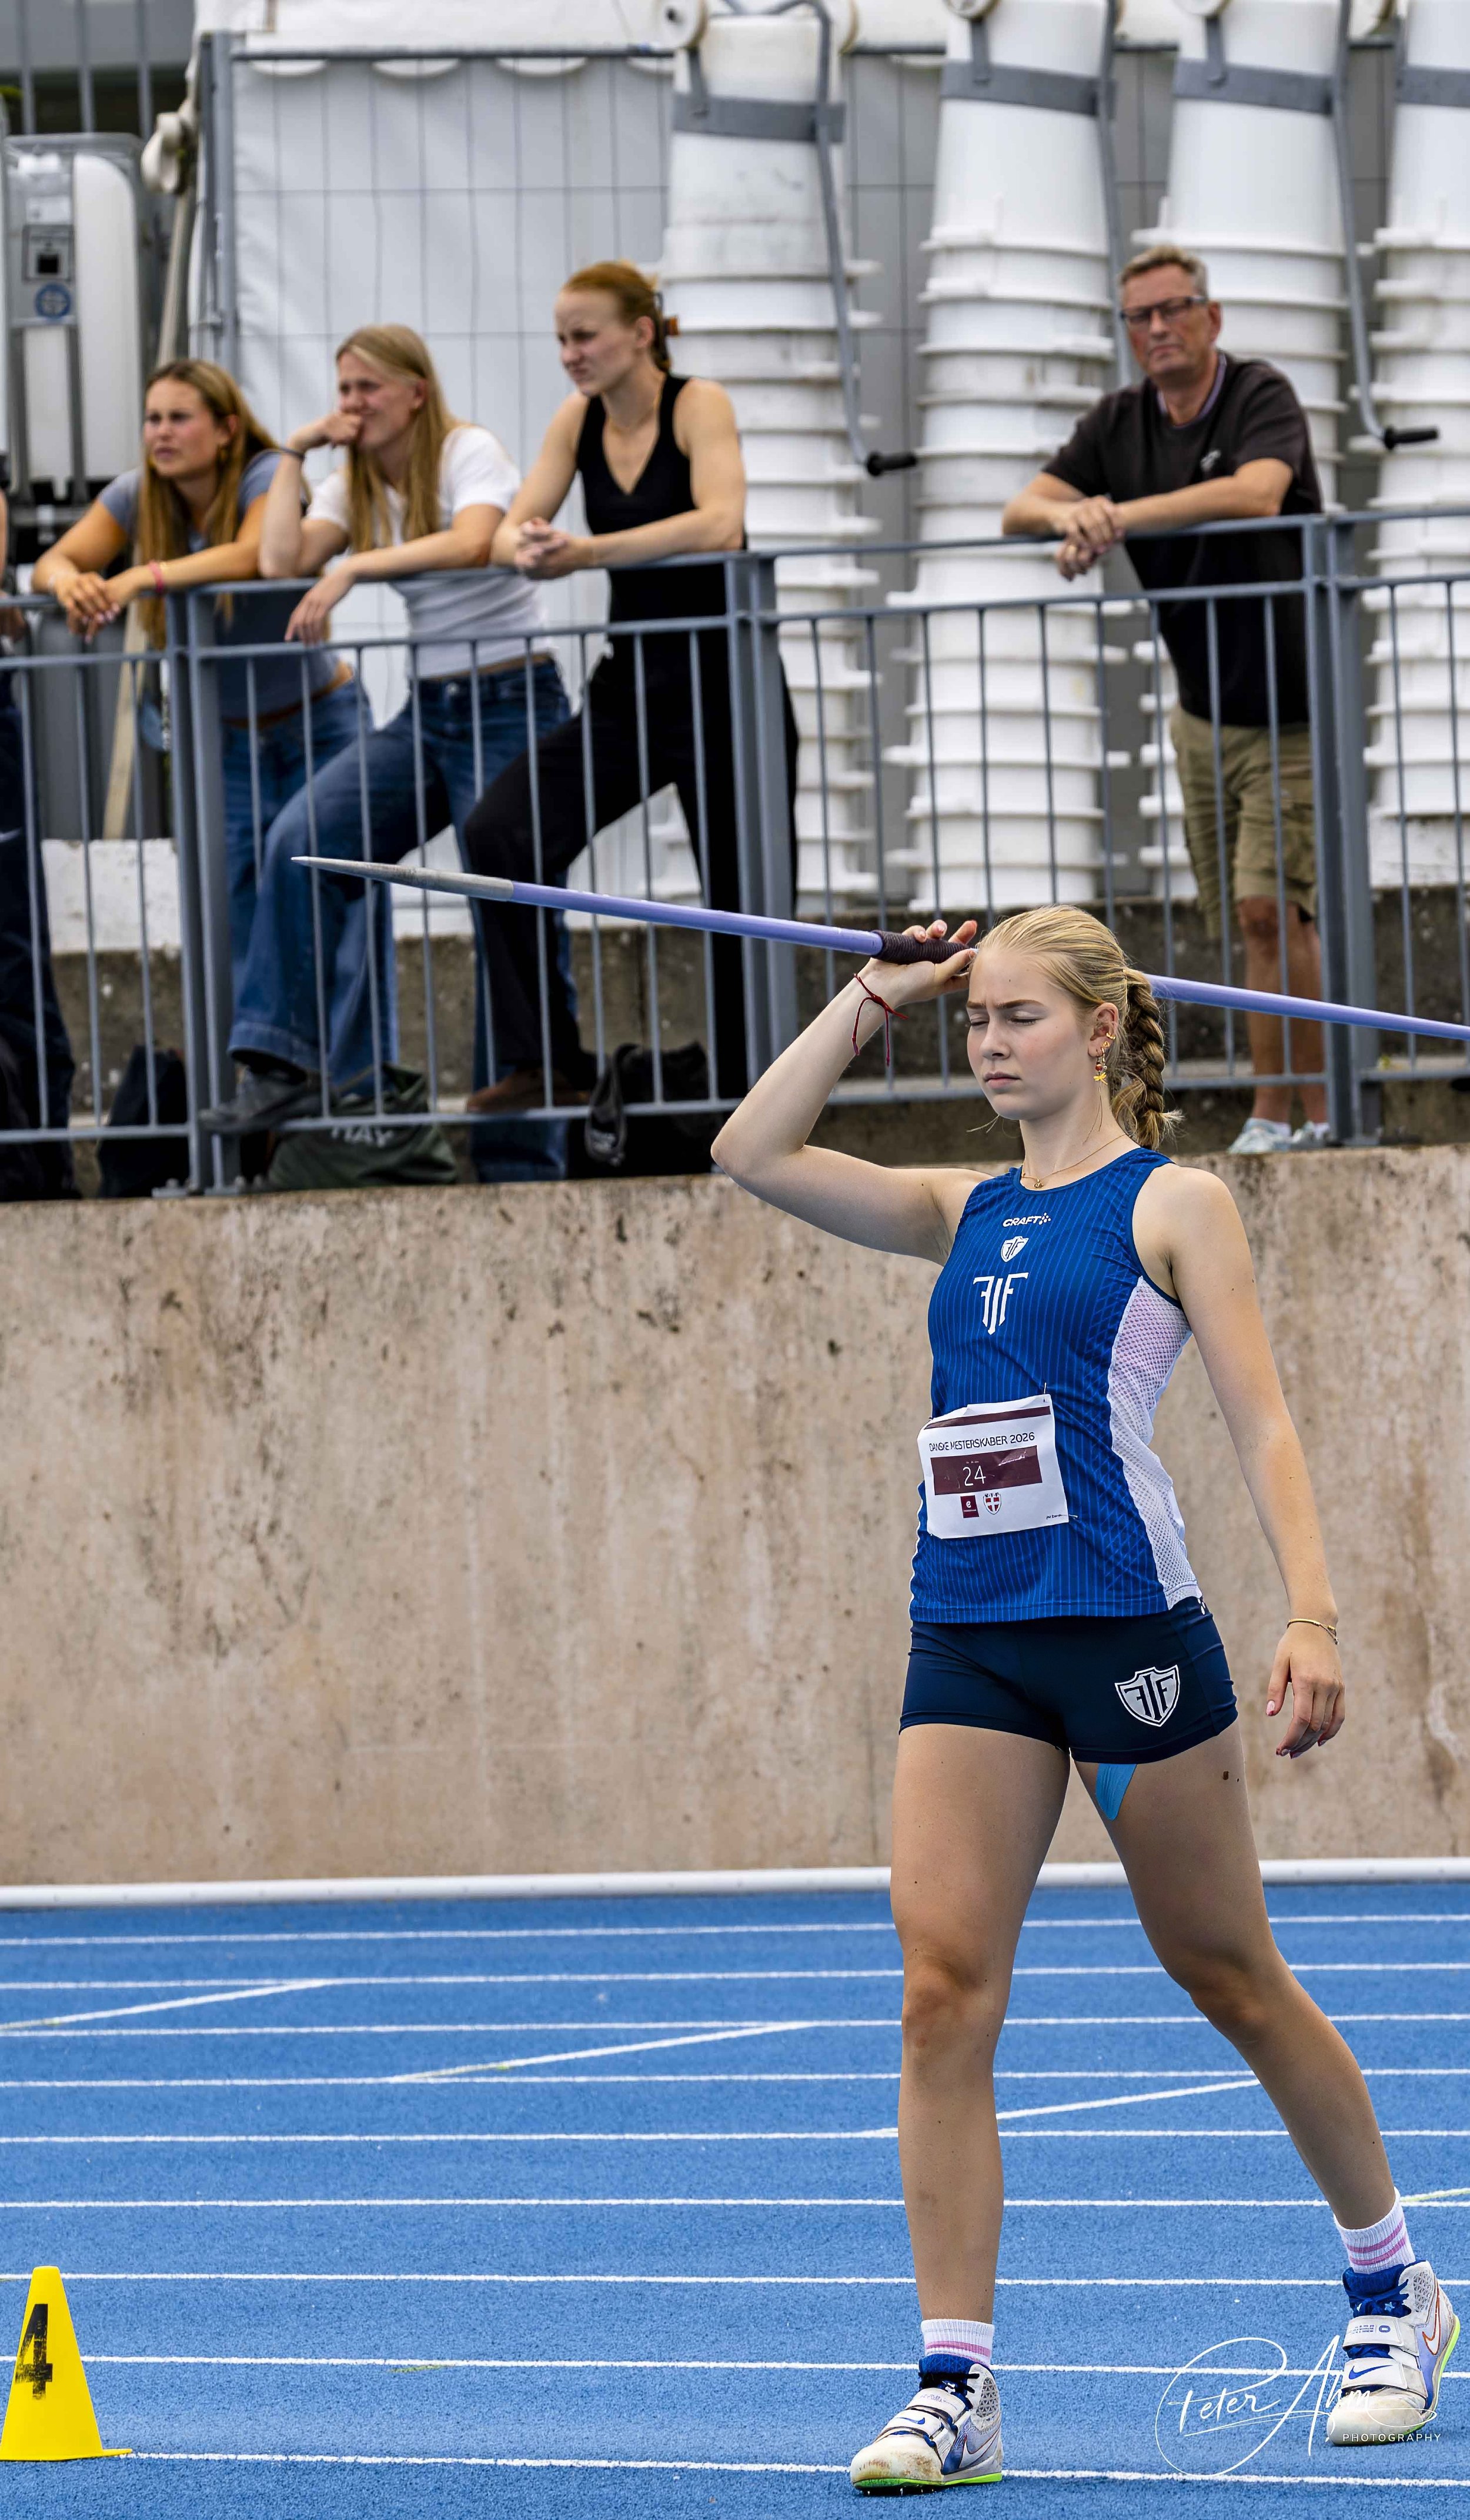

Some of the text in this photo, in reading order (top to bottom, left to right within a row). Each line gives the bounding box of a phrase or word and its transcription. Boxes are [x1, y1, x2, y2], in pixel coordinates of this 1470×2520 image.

[1003, 1216, 1041, 1227] CRAFT
[950, 1435, 1008, 1450] MESTERSKABER
[1009, 1431, 1035, 1444] 2026
[963, 1465, 987, 1486] 24
[15, 2303, 54, 2400] 4
